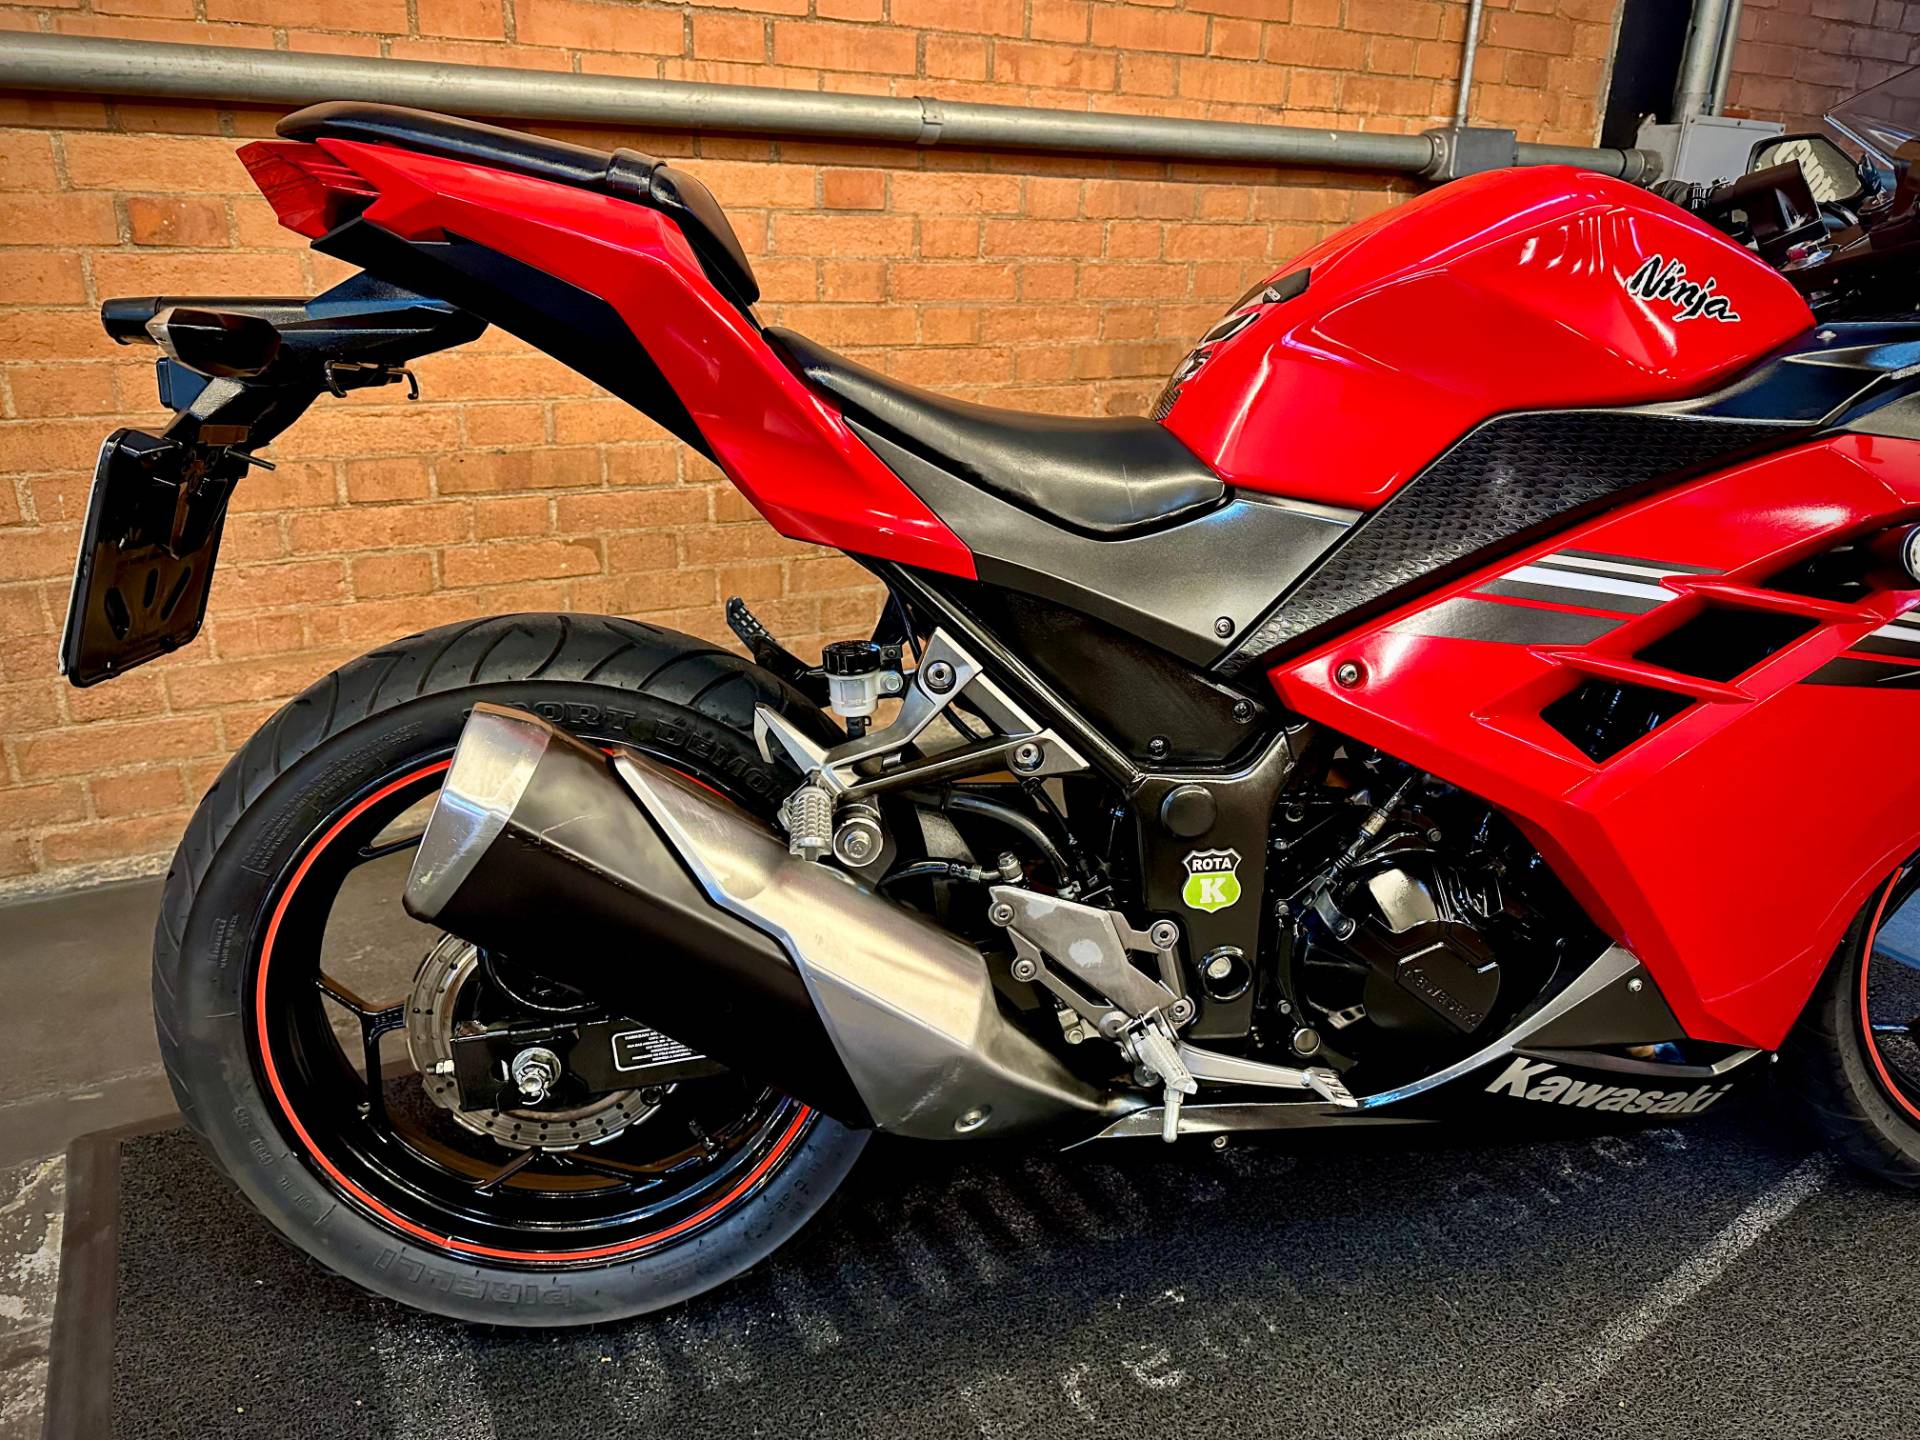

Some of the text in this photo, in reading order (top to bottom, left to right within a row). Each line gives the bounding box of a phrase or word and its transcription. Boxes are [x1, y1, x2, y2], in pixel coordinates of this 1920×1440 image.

[1626, 254, 1741, 323] Ninja
[506, 701, 638, 731] ORT
[1191, 857, 1233, 872] ROTA
[1199, 877, 1227, 904] K
[1484, 1056, 1735, 1114] Kawasaki
